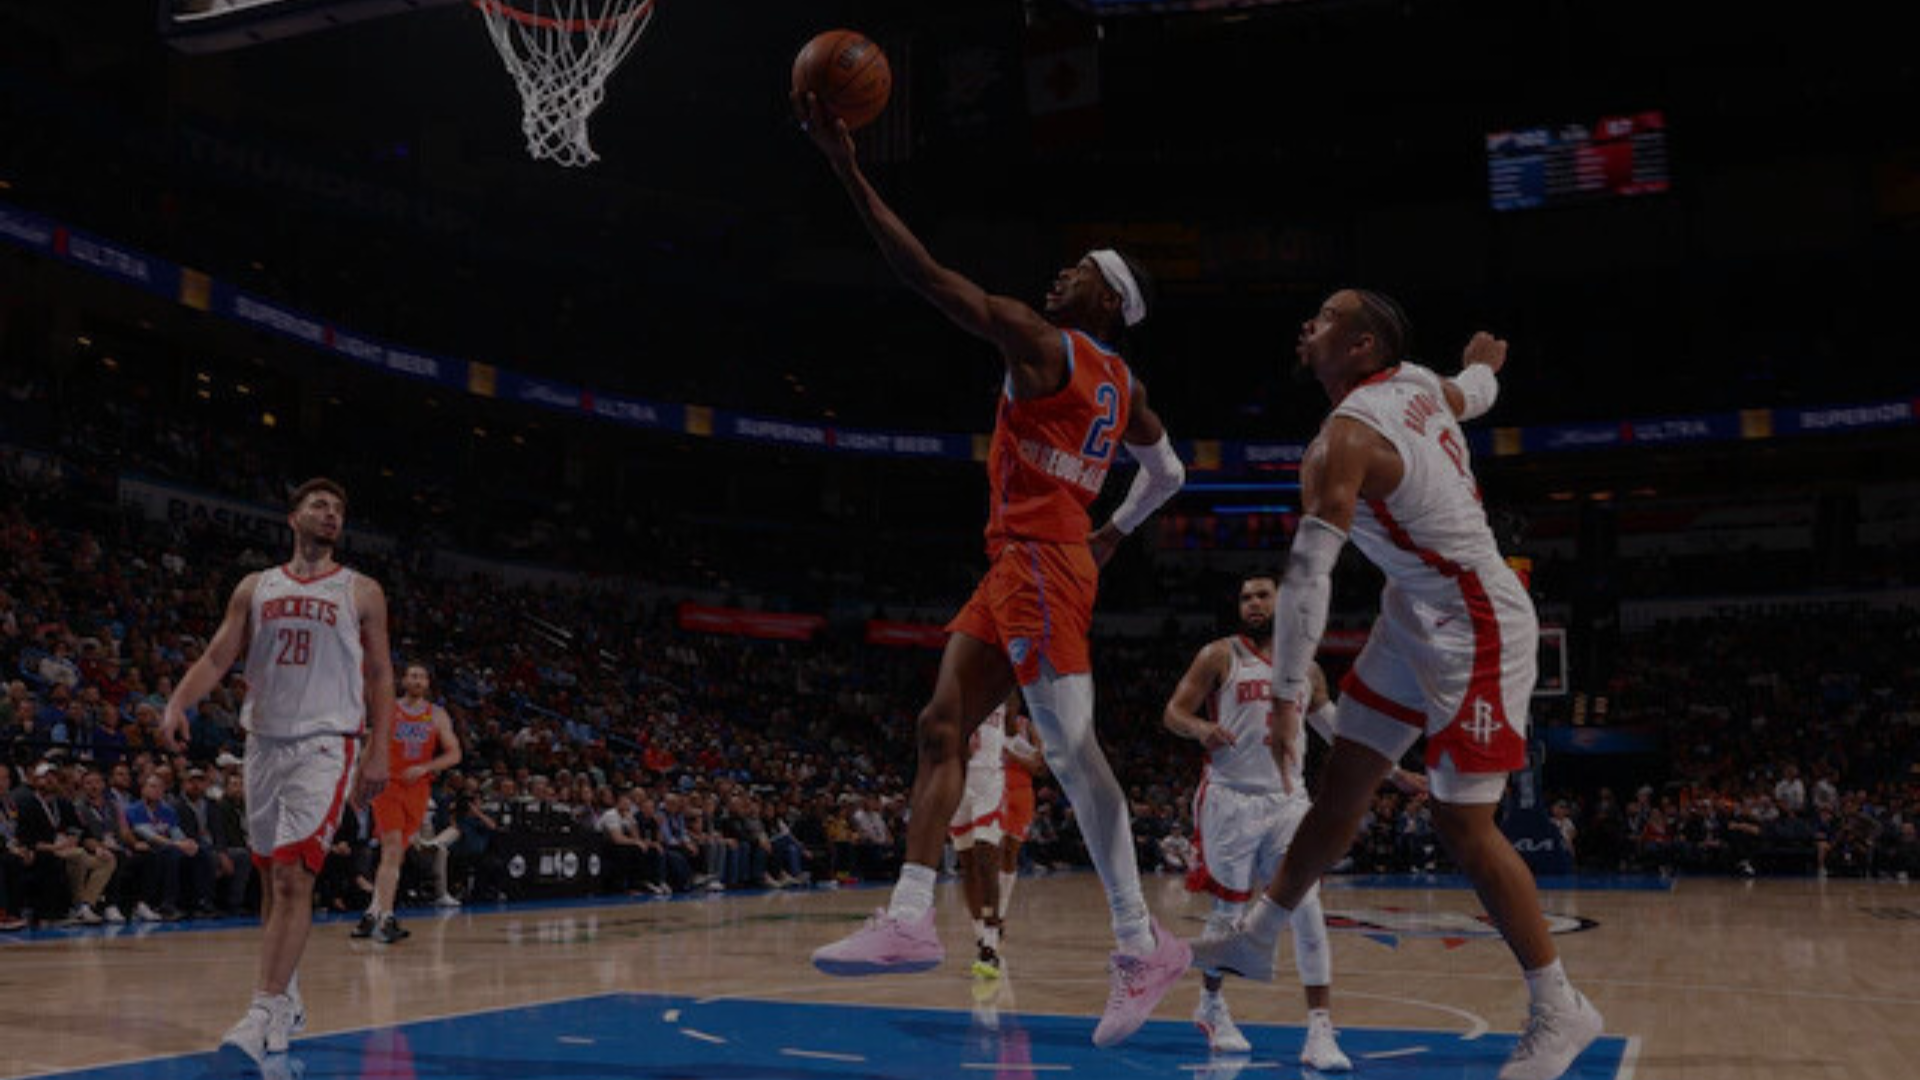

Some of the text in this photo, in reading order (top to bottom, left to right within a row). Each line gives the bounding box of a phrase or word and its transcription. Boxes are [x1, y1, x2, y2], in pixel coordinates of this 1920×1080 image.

[1082, 382, 1118, 459] 2
[262, 595, 338, 627] ROCKETS
[276, 628, 310, 665] 28
